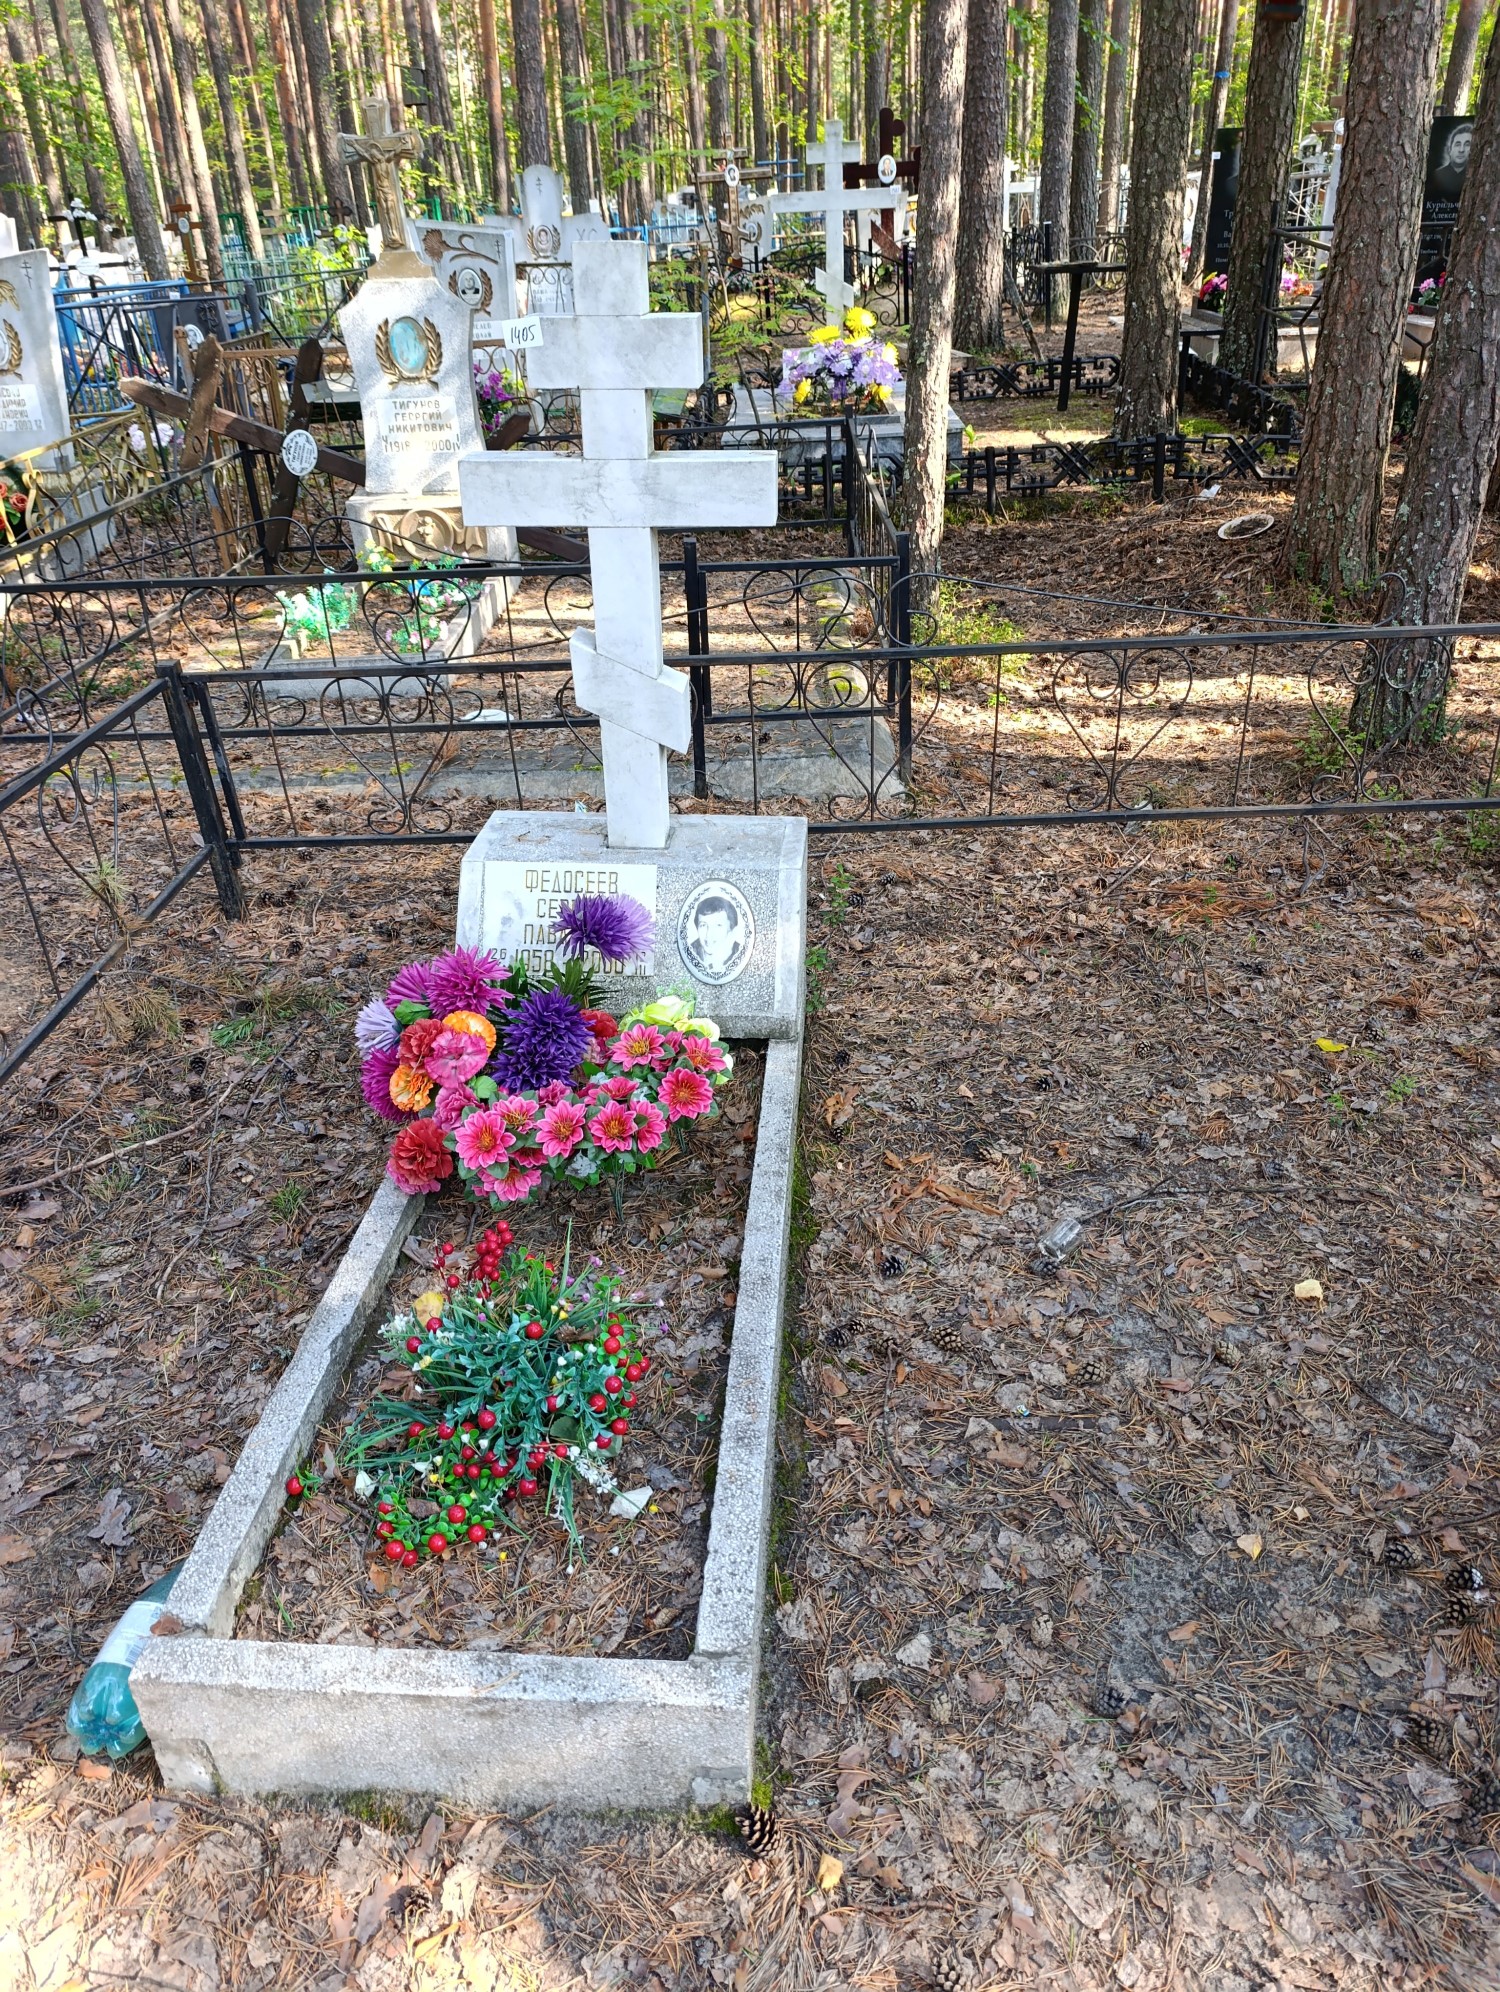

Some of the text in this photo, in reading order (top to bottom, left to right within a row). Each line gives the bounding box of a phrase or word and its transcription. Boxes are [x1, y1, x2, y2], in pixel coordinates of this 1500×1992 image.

[1224, 209, 1234, 220] Тр
[511, 324, 536, 345] 1405
[392, 400, 441, 411] ТИГУНОВ
[394, 410, 442, 422] ГЕОРГИЙ
[388, 423, 452, 434] НИКИТОВИЧ
[525, 869, 619, 894] ФЕДОСЕЕВ
